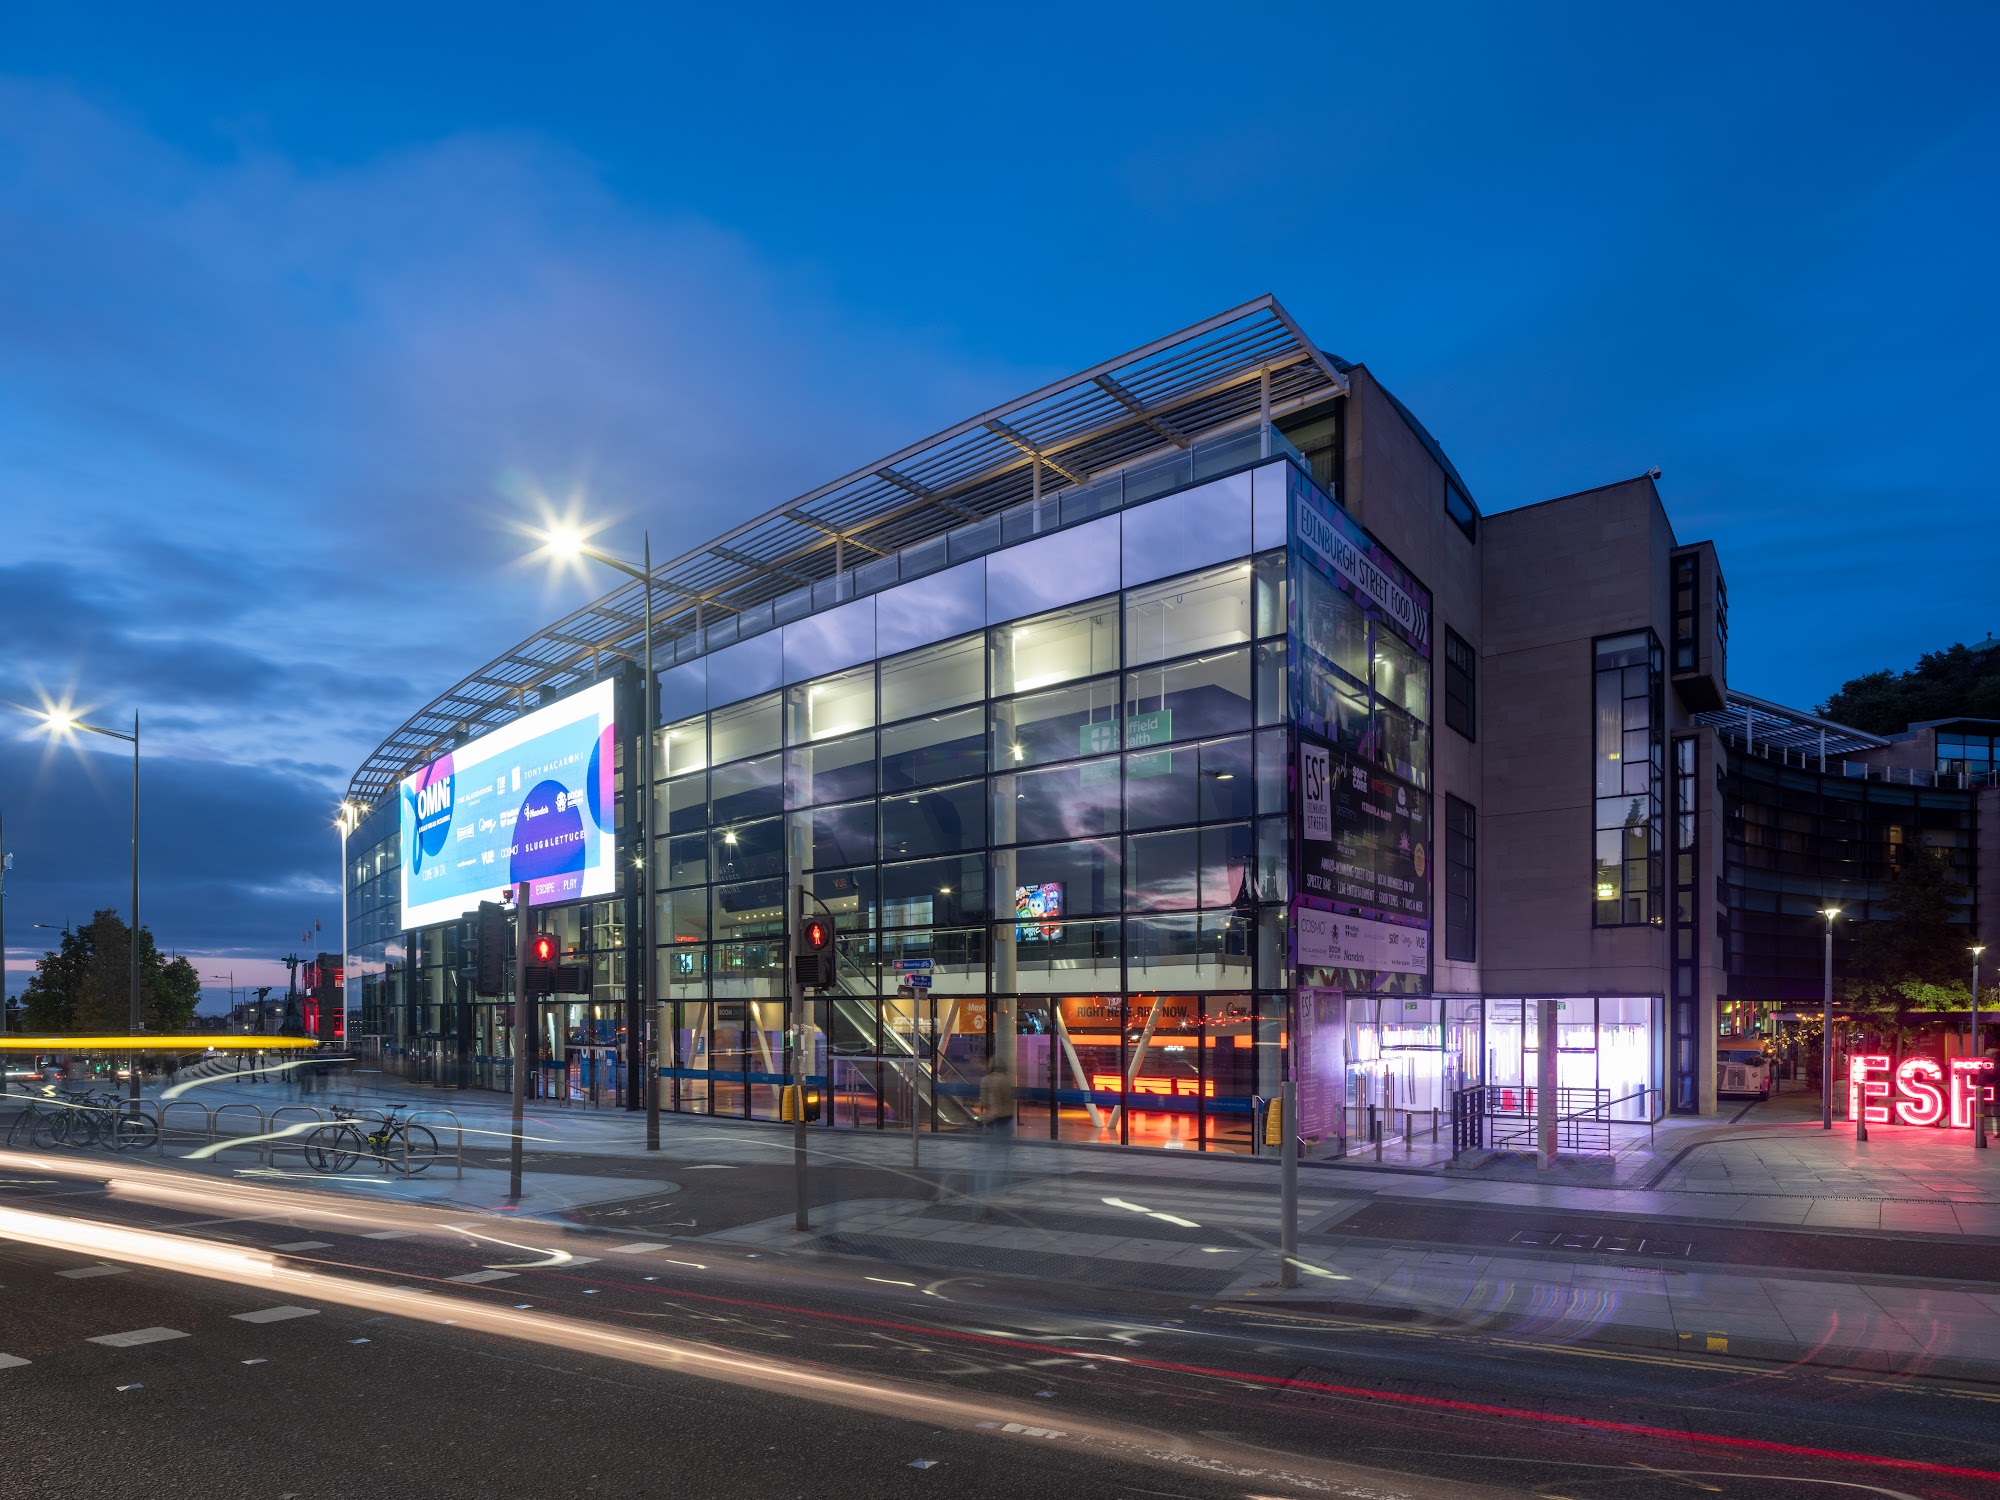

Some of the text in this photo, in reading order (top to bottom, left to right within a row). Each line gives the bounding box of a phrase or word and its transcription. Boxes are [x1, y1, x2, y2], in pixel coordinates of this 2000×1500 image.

[1301, 503, 1411, 623] EDINBURGH STREET FOOD
[1114, 717, 1158, 736] Nffield
[1114, 733, 1151, 750] Halth
[523, 752, 584, 780] TONY MACARONI
[1352, 765, 1368, 779] SOFT
[1306, 754, 1325, 801] ESF
[1352, 777, 1368, 793] CORE
[525, 840, 544, 853] SLUG
[550, 829, 586, 847] LETTUCE
[535, 882, 555, 896] ESCAPE
[563, 878, 577, 891] PLAY
[1300, 918, 1326, 935] COSMO
[1329, 945, 1341, 954] BOOM
[1343, 949, 1364, 962] Nando's
[719, 1008, 733, 1016] BOOM
[1077, 1006, 1104, 1018] RIGHT
[1107, 1006, 1134, 1018] HEE.
[1301, 995, 1313, 1018] ESF
[1848, 1054, 1994, 1128] ESF
